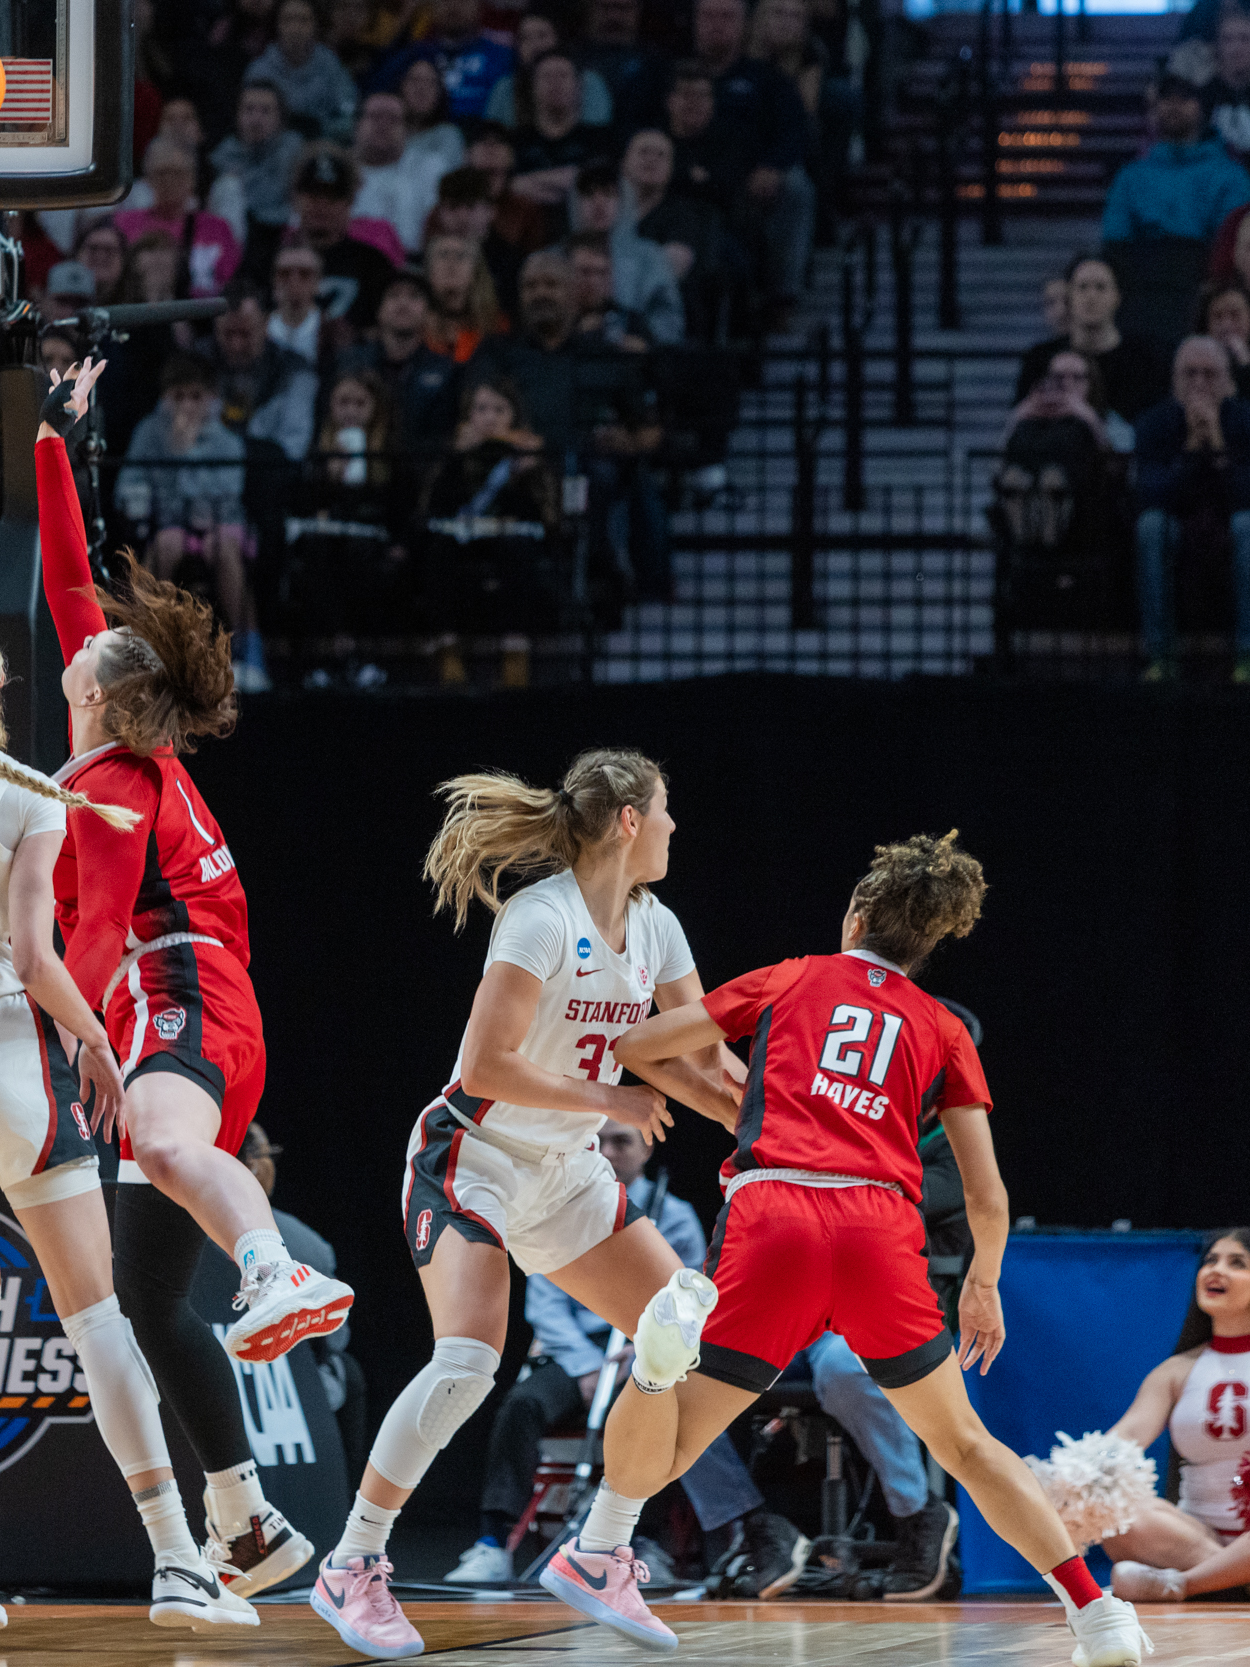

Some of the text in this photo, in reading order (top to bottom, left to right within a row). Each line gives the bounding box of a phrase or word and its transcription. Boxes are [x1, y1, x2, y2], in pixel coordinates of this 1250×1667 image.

[175, 777, 216, 846] 1
[575, 1033, 623, 1081] 3
[818, 1003, 904, 1089] 21
[810, 1072, 890, 1121] HAYES
